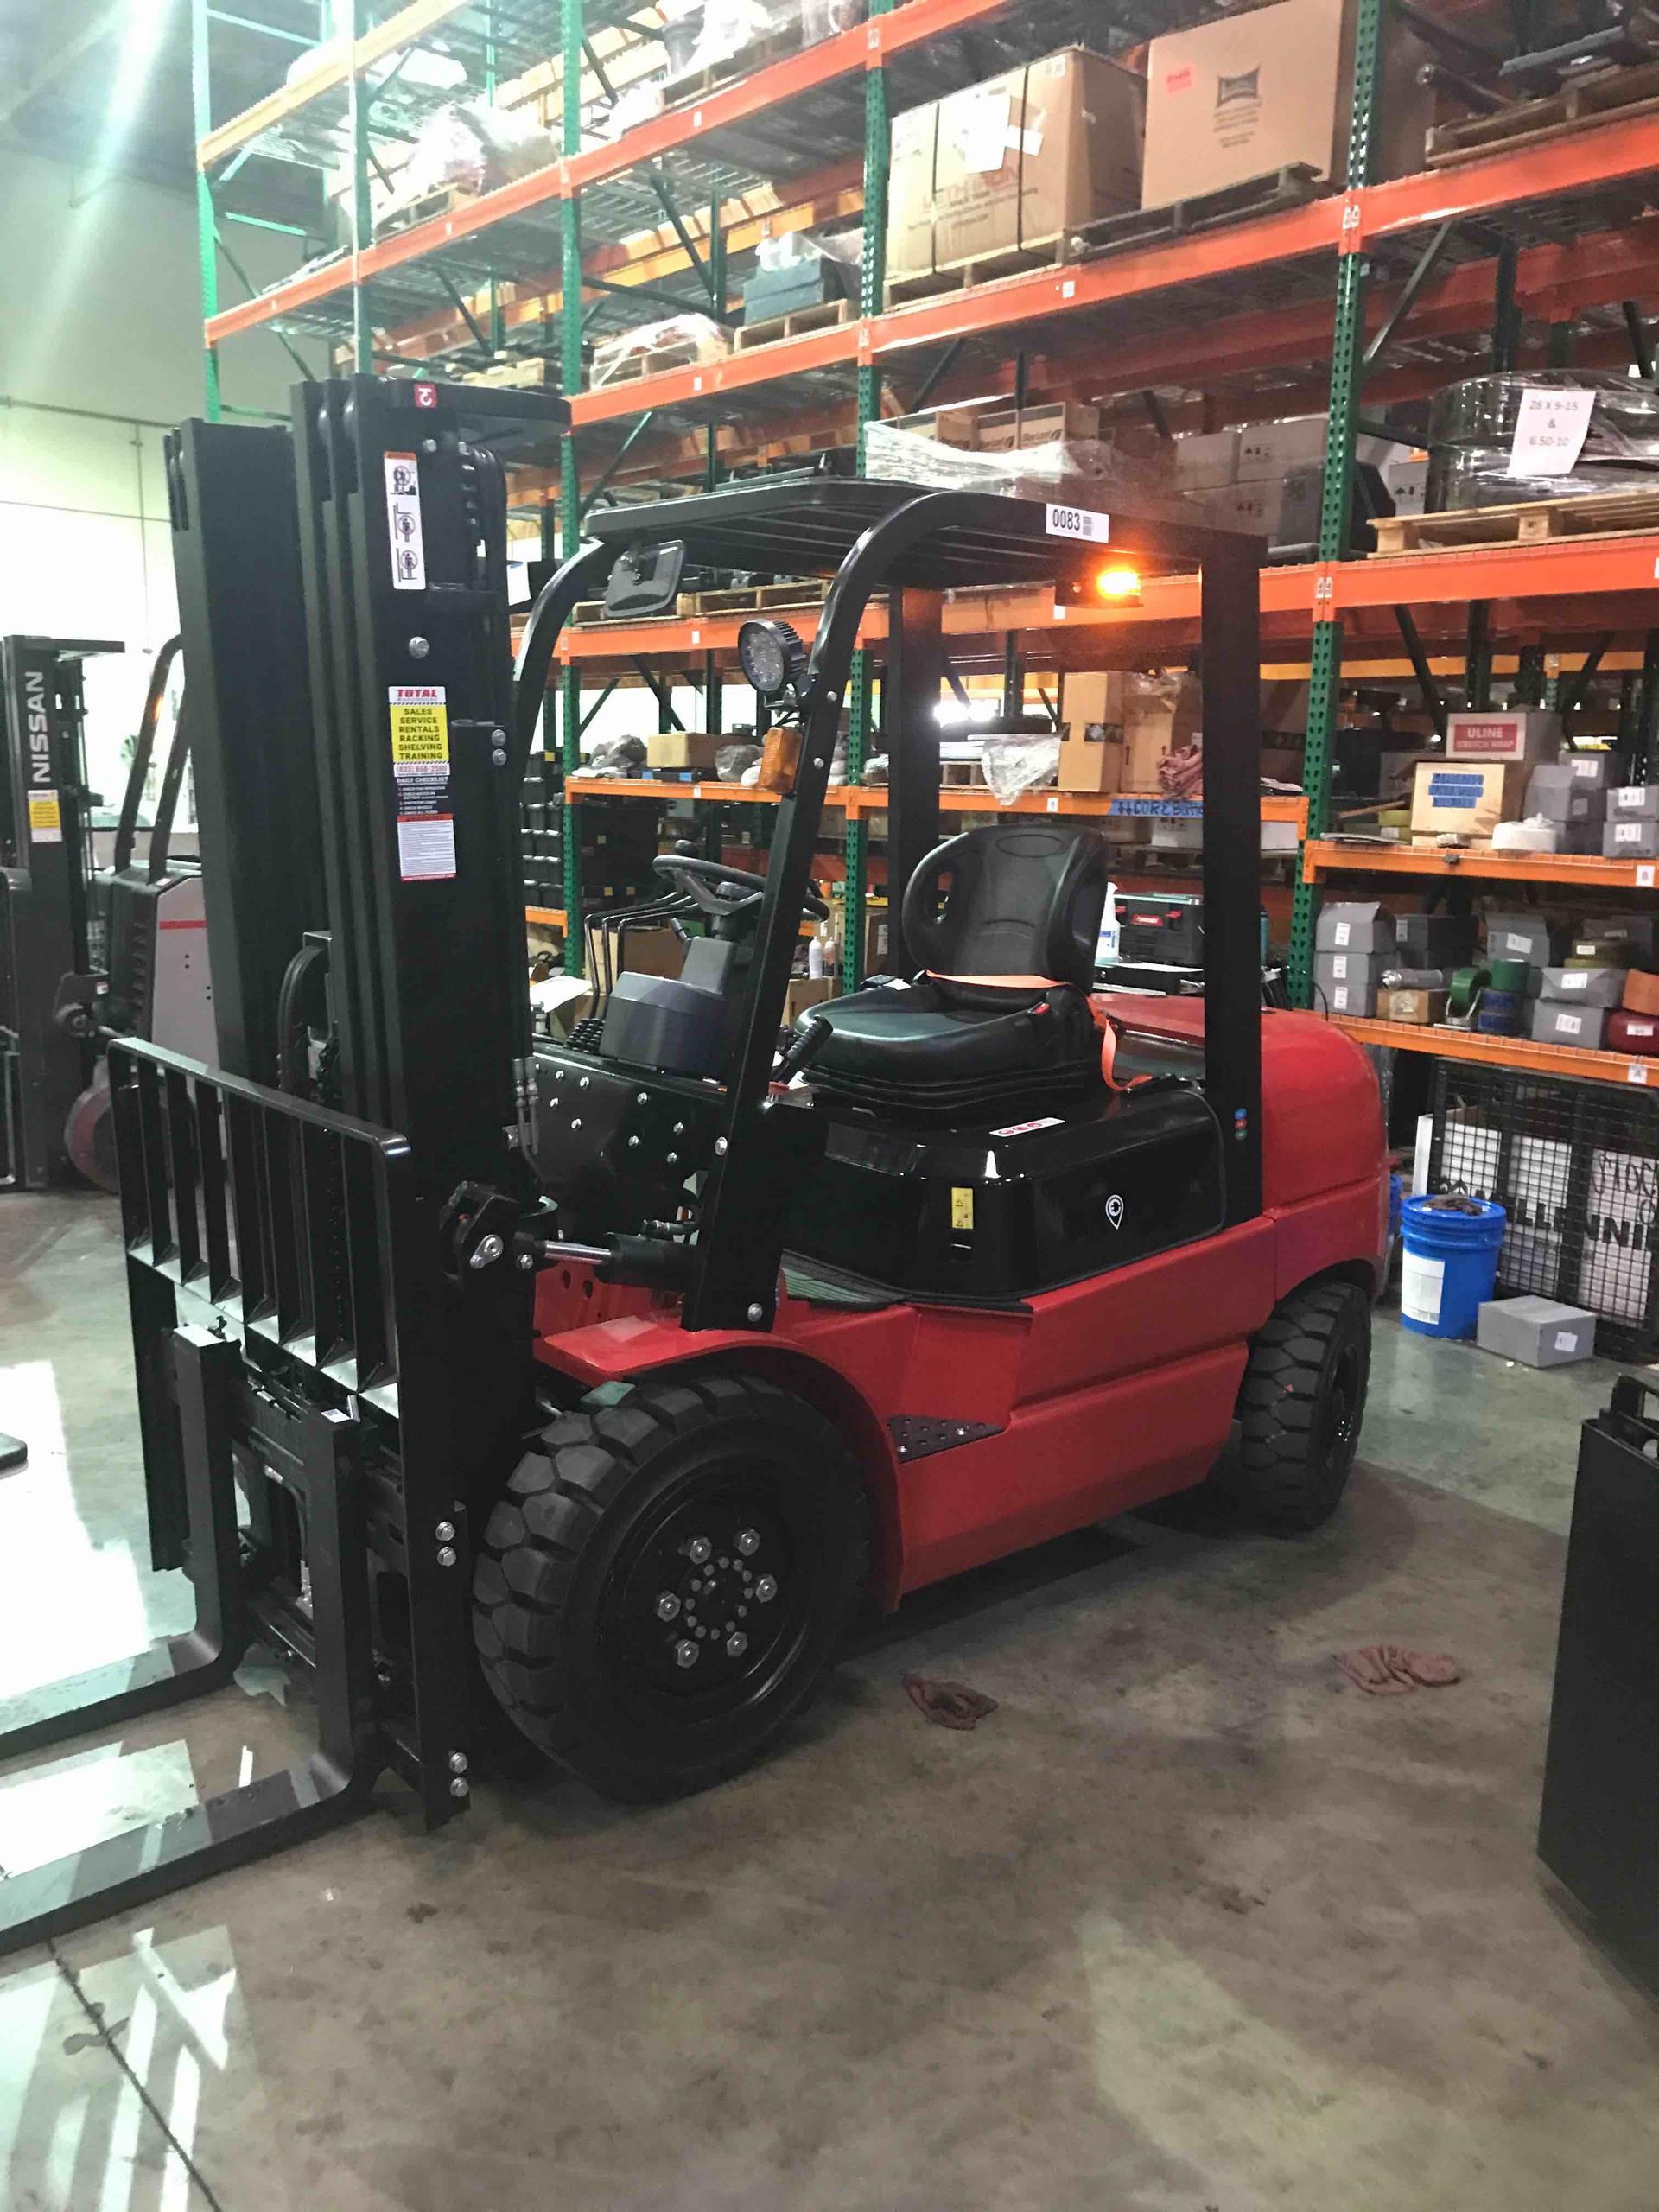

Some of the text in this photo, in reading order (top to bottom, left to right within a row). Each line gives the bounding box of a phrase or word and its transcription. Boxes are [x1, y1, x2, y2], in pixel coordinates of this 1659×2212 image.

[1548, 418, 1556, 429] &
[1052, 508, 1081, 531] 0083
[397, 689, 438, 698] TOTAL
[400, 716, 439, 725] SERVICE
[25, 671, 52, 783] NISSAN
[398, 725, 440, 734] RENTALS
[1466, 727, 1503, 739] ULINE
[398, 752, 443, 760] TRAINING
